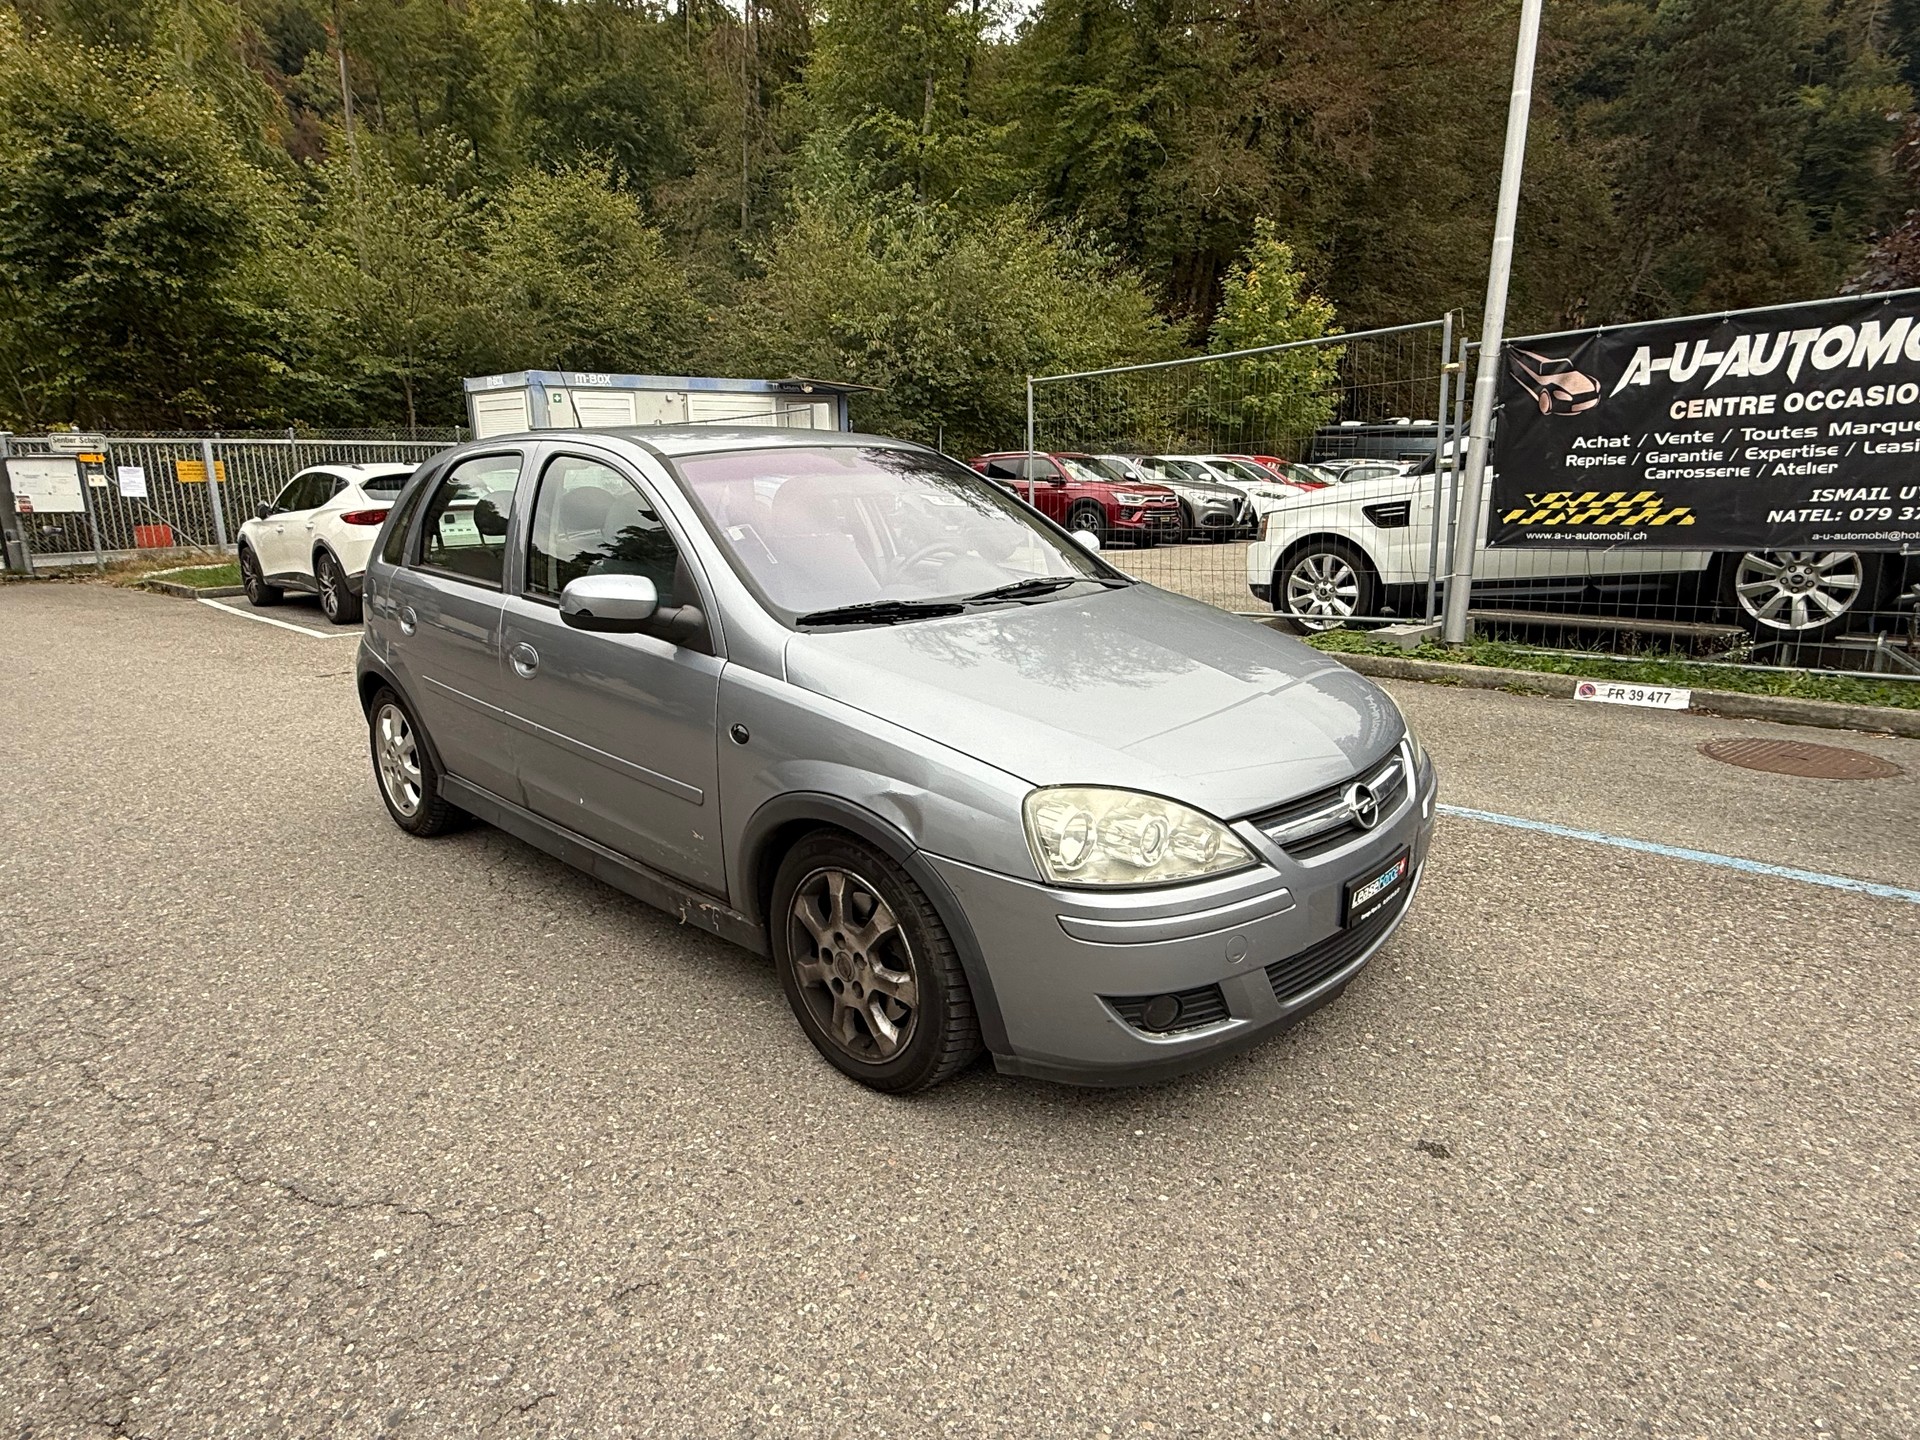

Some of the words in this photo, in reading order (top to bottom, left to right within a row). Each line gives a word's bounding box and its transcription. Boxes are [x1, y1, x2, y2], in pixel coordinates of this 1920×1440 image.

[1669, 394, 1776, 419] CENTRE
[1783, 383, 1920, 413] OCCASIO
[1572, 434, 1631, 449] Achat
[1654, 430, 1714, 445] Vente
[1740, 426, 1818, 441] Toutes
[1565, 454, 1627, 468] Reprise
[1645, 449, 1723, 464] Garantie
[1744, 444, 1839, 462] Expertise
[1644, 466, 1751, 480] Carrosserie
[1771, 461, 1838, 476] Atelier
[1809, 487, 1891, 502] ISMAIL
[1899, 486, 1920, 500] U
[1766, 509, 1843, 523] NATEL:
[1849, 507, 1892, 521] 079
[1526, 531, 1648, 541] www.a-u-automobil.ch
[1812, 531, 1920, 541] a-u-automobil@hot
[1607, 688, 1625, 700] FR
[1628, 690, 1644, 701] 39
[1647, 691, 1671, 704] 477
